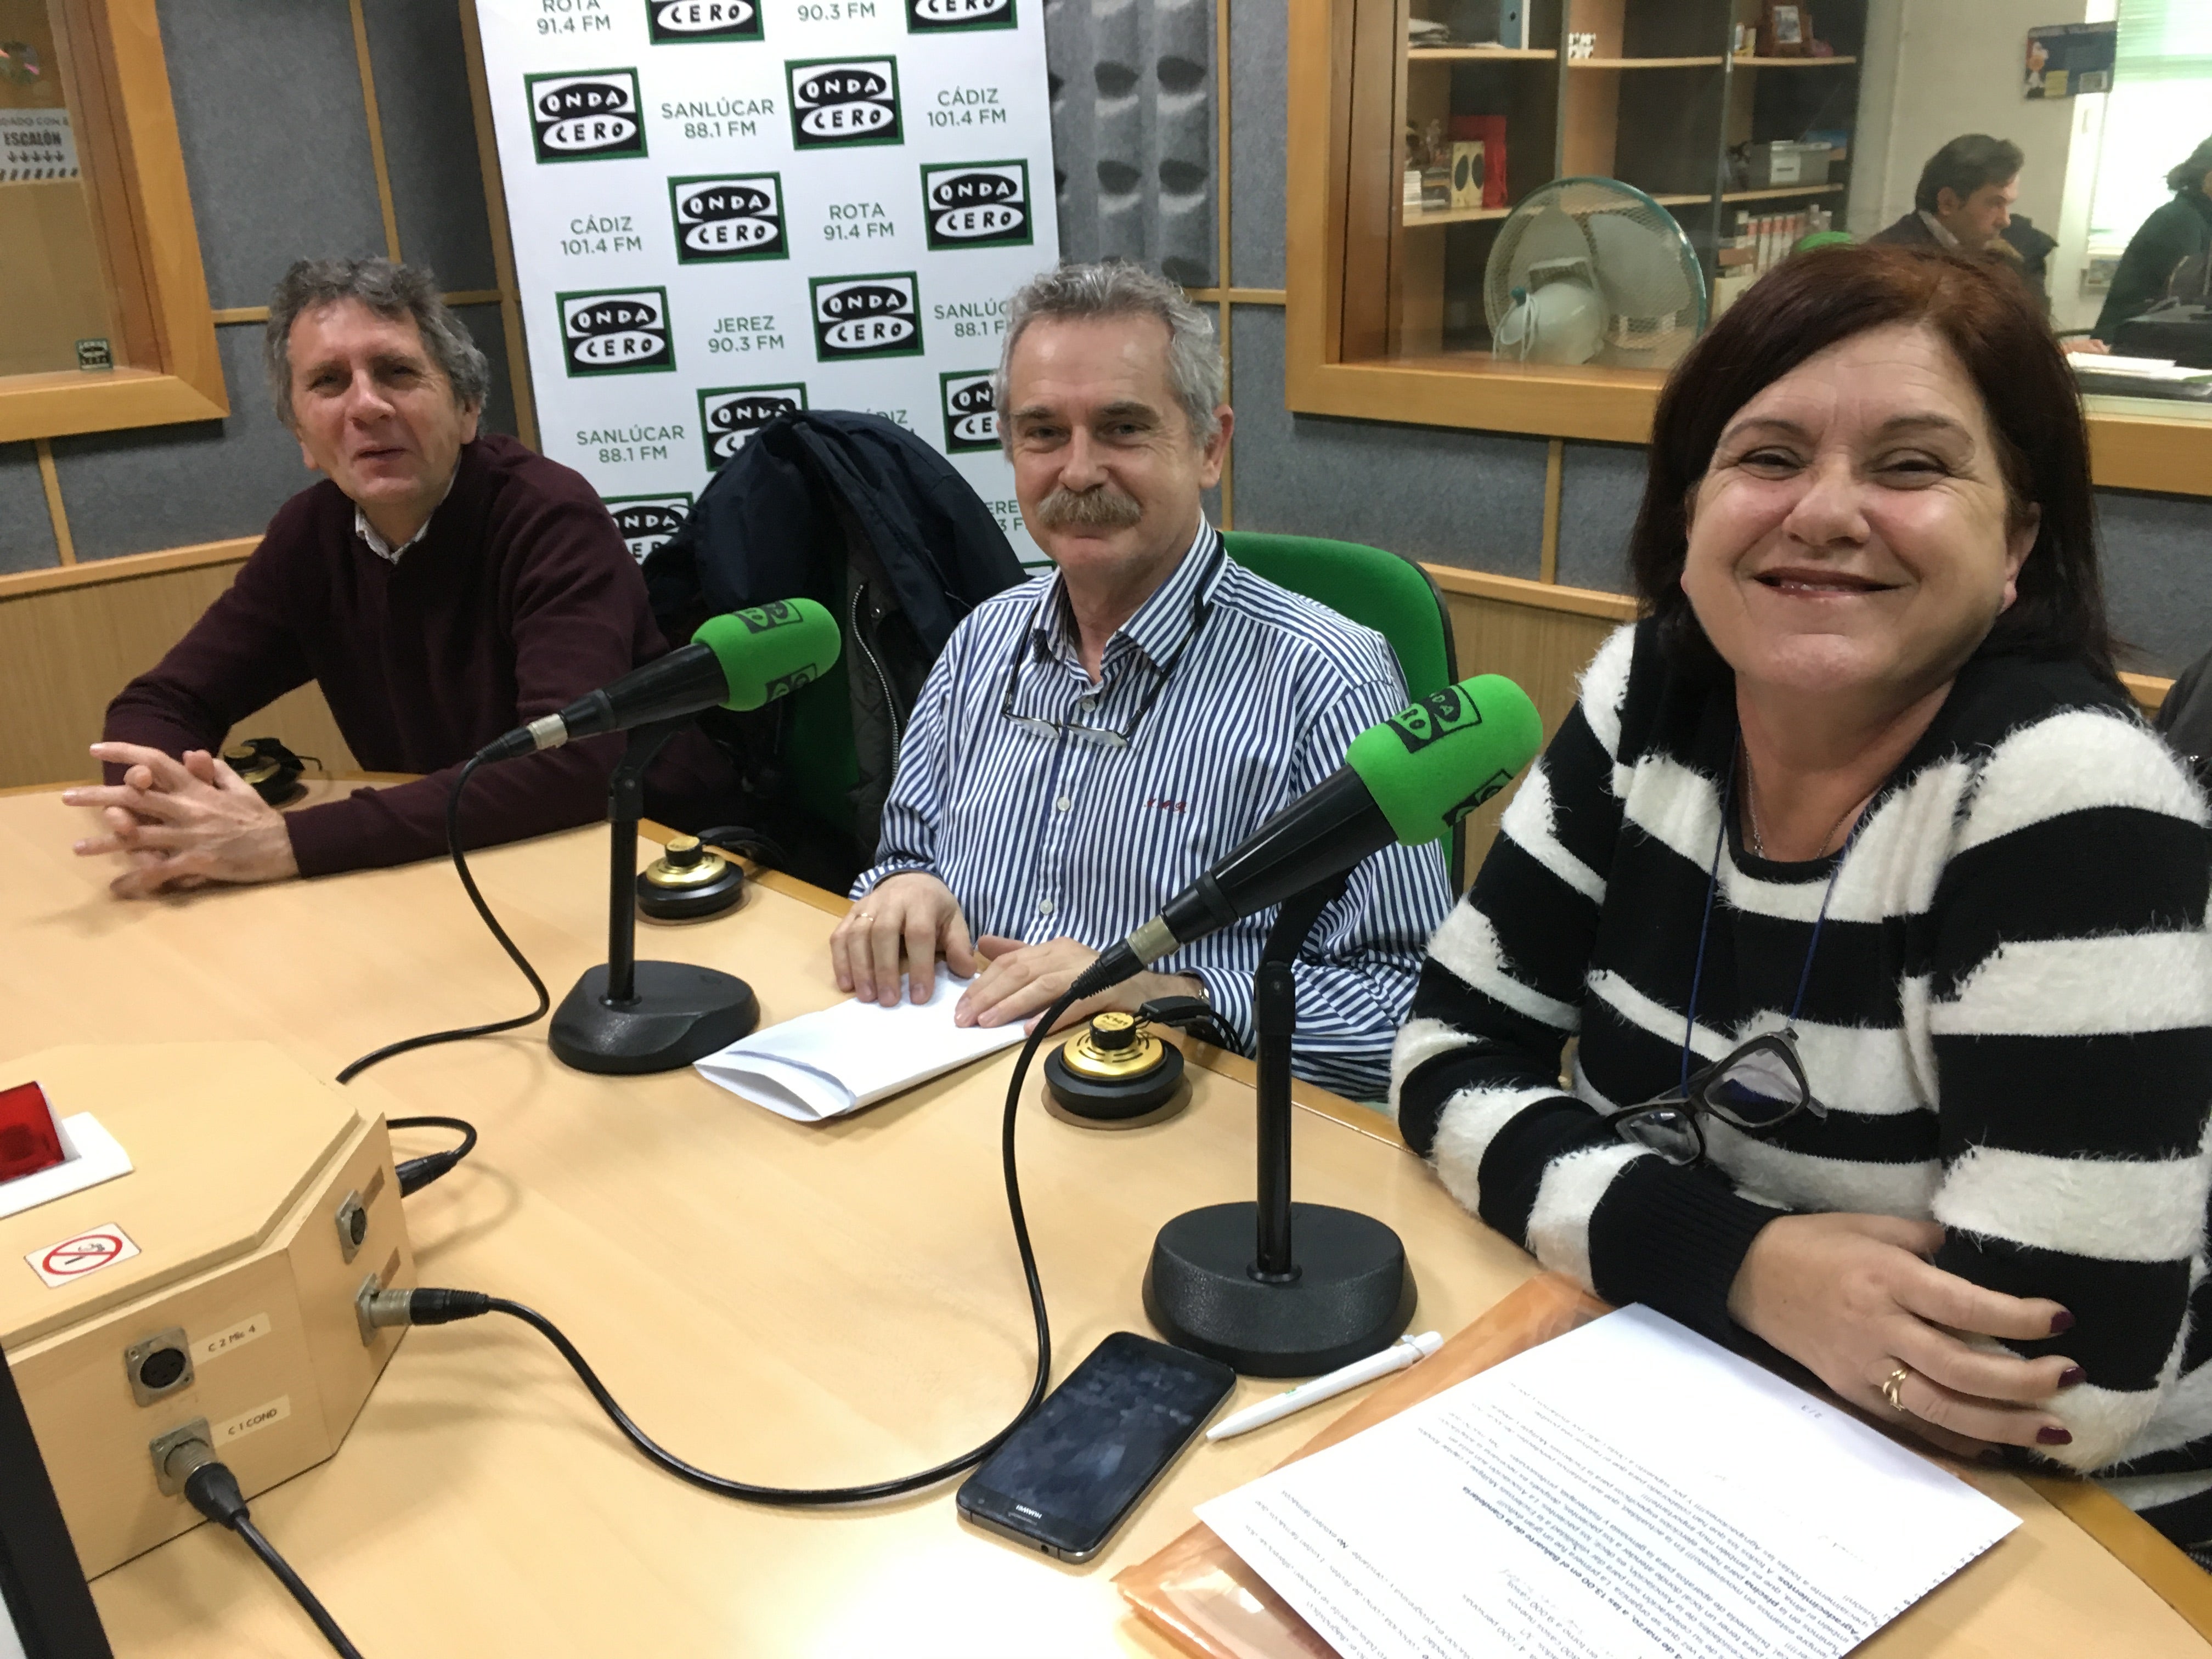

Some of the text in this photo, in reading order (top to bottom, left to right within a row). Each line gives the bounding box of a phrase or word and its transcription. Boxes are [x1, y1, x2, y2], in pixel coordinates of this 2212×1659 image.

[671, 3, 740, 24] CERO
[797, 2, 876, 22] 90.3 FM
[537, 14, 611, 35] 91.4 FM
[806, 77, 880, 99] ONDA
[937, 86, 1000, 107] CÁDIZ
[546, 89, 622, 112] ONDA
[661, 97, 776, 120] SANLÚCAR
[814, 109, 882, 129] CERO
[927, 109, 1007, 127] 101.4 FM
[3, 129, 62, 146] ESCALÓN
[556, 121, 624, 143] CERO
[684, 121, 757, 139] 88.1 FM
[940, 181, 1012, 201] ONDA
[690, 194, 764, 215] ONDA
[829, 202, 885, 221] ROTA
[569, 215, 633, 236] CÁDIZ
[823, 221, 895, 241] 91.4 FM
[947, 210, 1012, 232] CERO
[697, 224, 766, 246] CERO
[560, 235, 642, 256] 101.4 FM
[829, 293, 901, 313] ONDA
[933, 297, 1007, 320] SANLÚC
[577, 307, 650, 330] ONDA
[713, 315, 776, 334] JEREZ
[837, 323, 903, 343] CERO
[954, 321, 988, 338] 88.1
[586, 336, 653, 358] CERO
[708, 334, 785, 354] 90.3 FM
[958, 390, 991, 407] ON
[576, 424, 685, 446] SANLÚCAR
[965, 416, 992, 435] CE
[599, 445, 668, 464] 88.1 FM
[613, 514, 678, 529] NDA
[1015, 1504, 1042, 1519] HUAWEI
